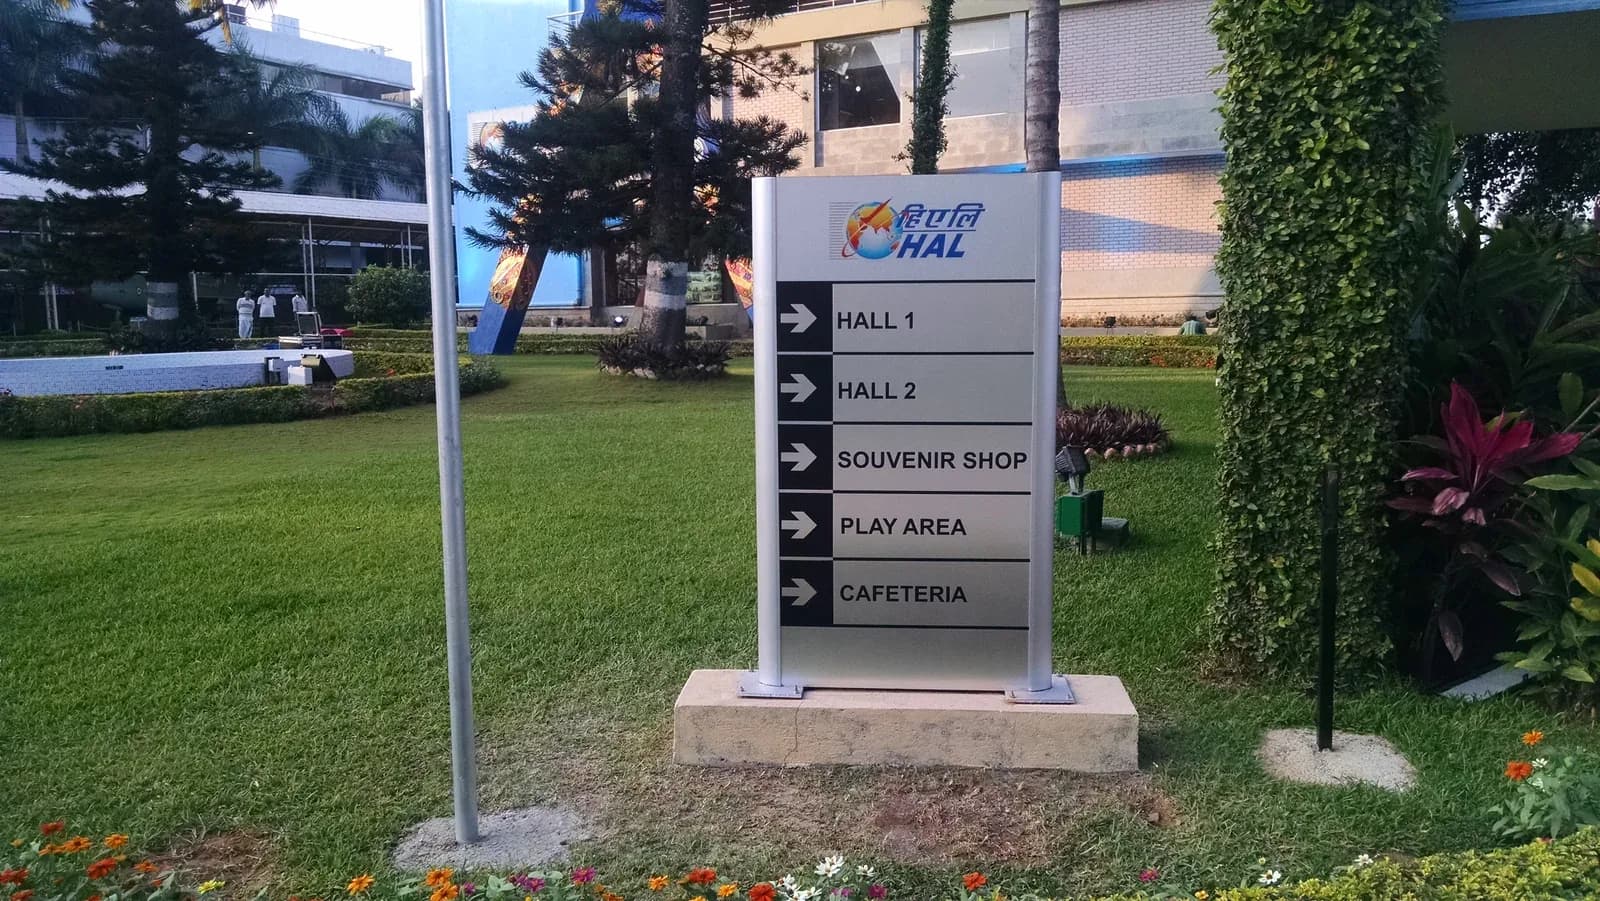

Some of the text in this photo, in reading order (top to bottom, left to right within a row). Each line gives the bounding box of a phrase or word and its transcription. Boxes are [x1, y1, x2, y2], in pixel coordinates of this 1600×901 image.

[896, 233, 966, 259] HAL
[837, 311, 915, 330] HALL 1
[838, 382, 917, 400] HALL 2
[837, 451, 1028, 470] SOUVENIR SHOP
[840, 517, 968, 536] PLAY AREA
[839, 584, 969, 603] CAFETERIA
